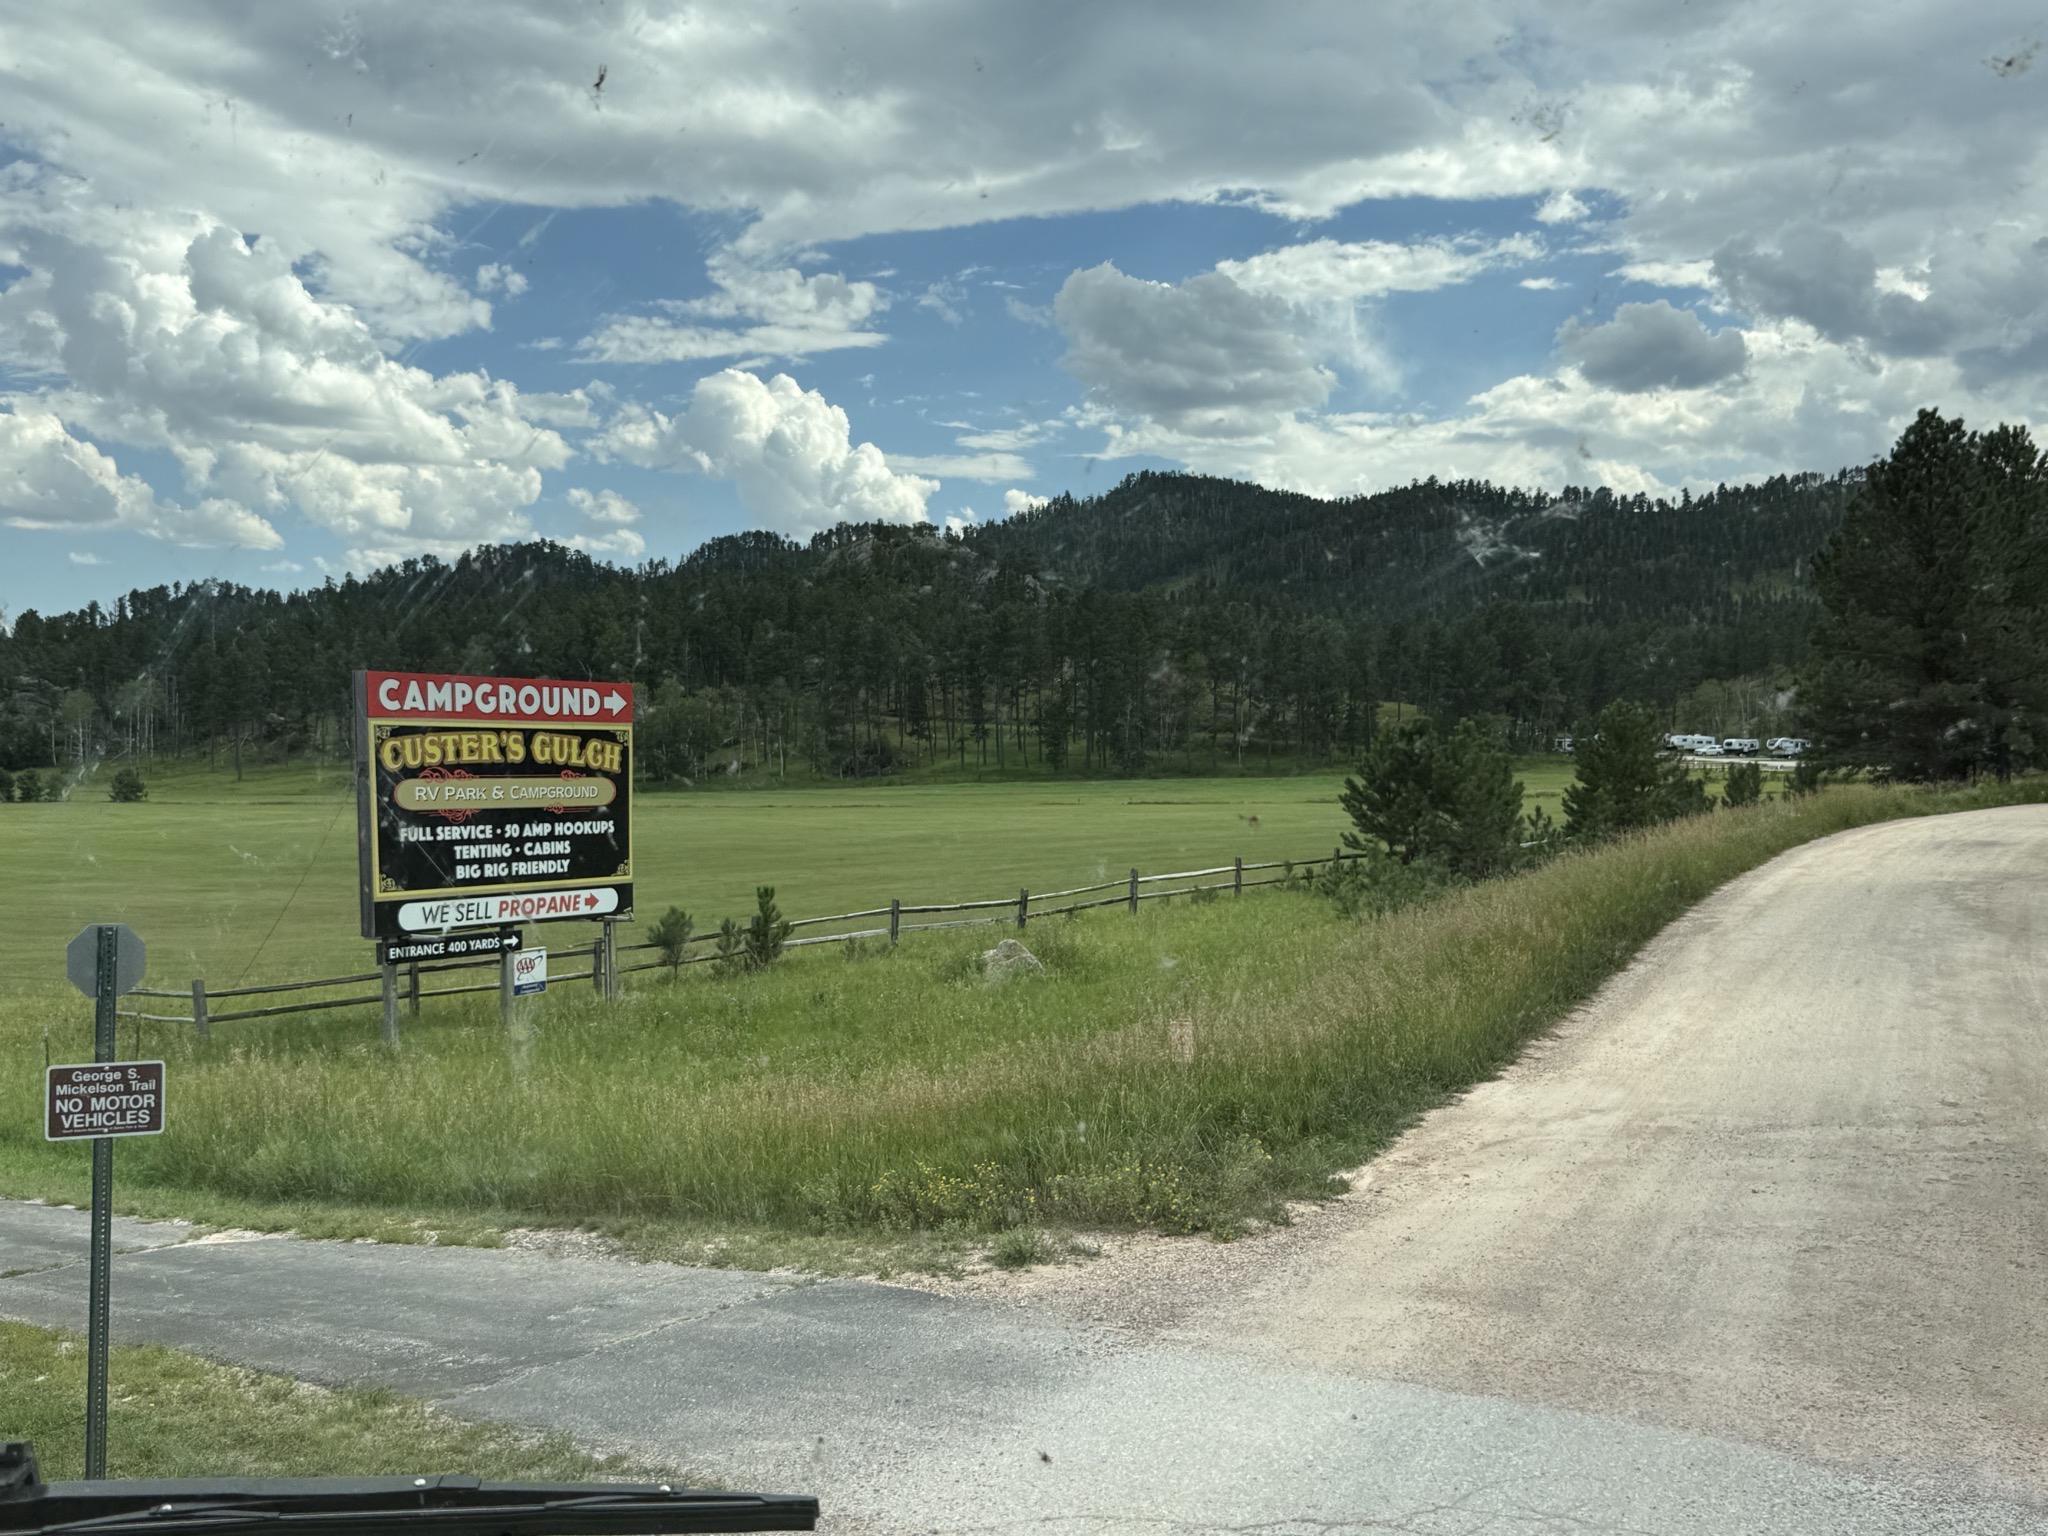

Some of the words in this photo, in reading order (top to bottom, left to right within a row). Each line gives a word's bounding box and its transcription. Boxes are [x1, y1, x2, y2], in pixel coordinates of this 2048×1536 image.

[379, 678, 601, 716] CAMPGROUND
[380, 731, 527, 772] CUSTER'S
[530, 731, 623, 773] GULCH
[415, 786, 441, 801] RV
[445, 786, 487, 801] PARK
[491, 788, 505, 800] &
[510, 785, 598, 799] CAMPGROUND
[400, 826, 434, 842] FULL
[436, 825, 493, 841] SERVICE
[504, 824, 520, 838] 50
[522, 823, 552, 837] AMP
[554, 820, 615, 836] HOOKUPS
[454, 843, 512, 859] TENTING
[523, 841, 571, 856] CABINS
[456, 864, 481, 879] BIG
[484, 862, 509, 877] RIG
[511, 859, 571, 876] FRIENDLY
[422, 903, 450, 924] WE
[455, 902, 493, 922] SELL
[498, 894, 581, 918] PROPANE
[389, 942, 445, 959] ENTRANCE
[447, 940, 467, 953] 400
[469, 937, 500, 951] YARDS
[72, 1071, 122, 1083] George
[127, 1068, 141, 1079] S.
[56, 1083, 124, 1096] Mickelson
[129, 1080, 156, 1092] Trail
[56, 1098, 83, 1113] NO
[90, 1094, 155, 1112] MOTOR
[61, 1110, 151, 1129] VEHICLES
